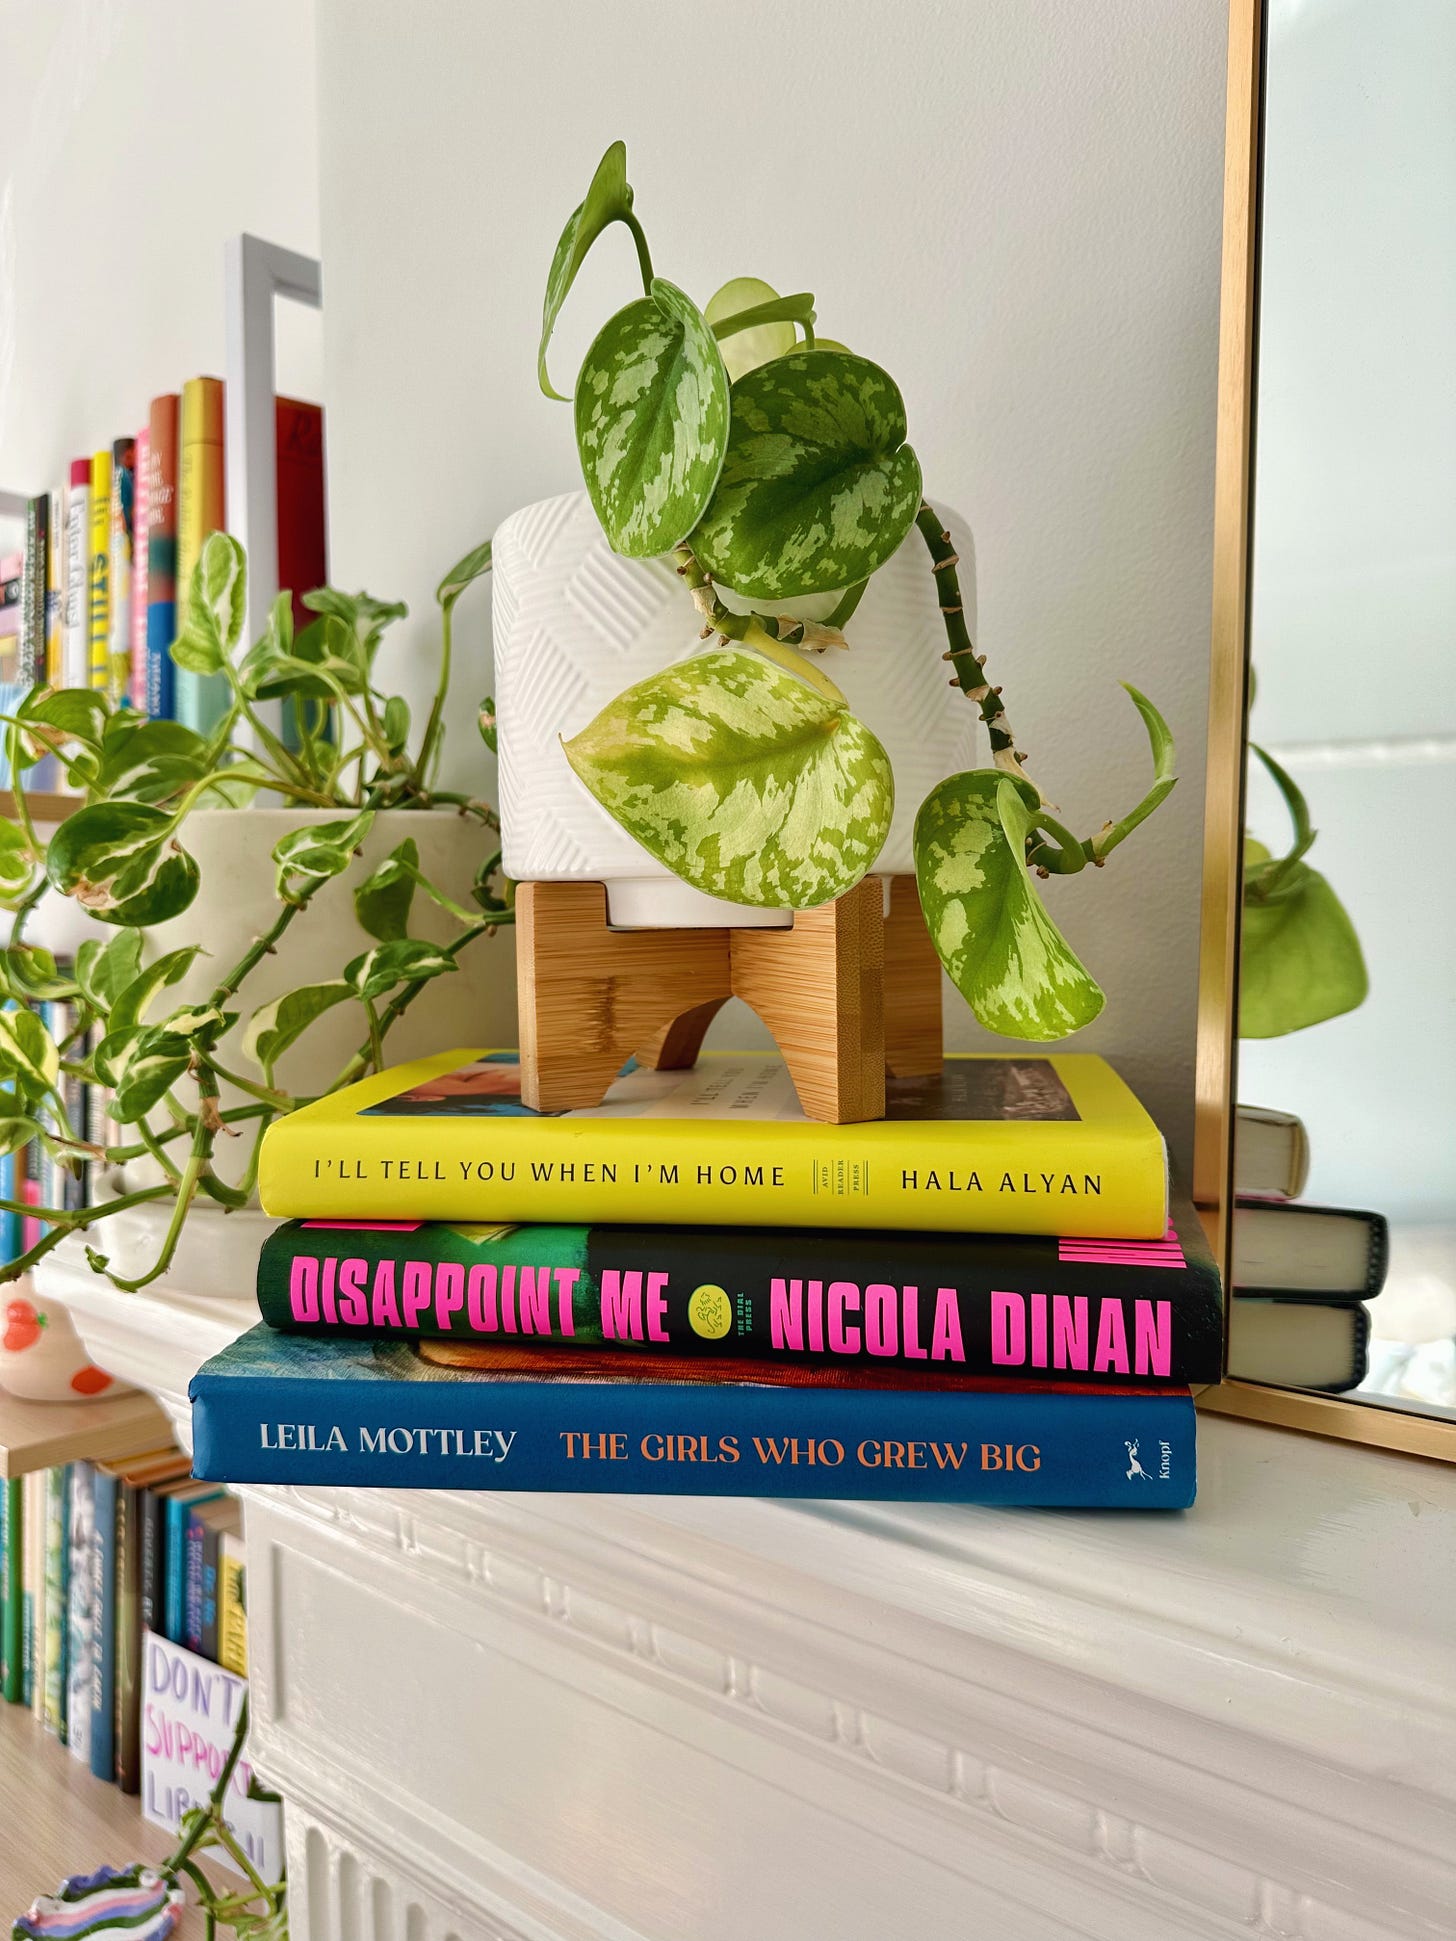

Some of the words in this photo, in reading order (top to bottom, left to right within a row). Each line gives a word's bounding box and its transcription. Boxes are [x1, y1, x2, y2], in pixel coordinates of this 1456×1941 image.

[315, 1159, 368, 1179] I'LL
[380, 1160, 446, 1180] TELL
[459, 1161, 515, 1181] YOU
[531, 1162, 617, 1183] WHEN
[634, 1164, 679, 1184] I'M
[697, 1165, 785, 1186] HOME
[852, 1164, 860, 1191] PRESS
[902, 1170, 983, 1192] HALA
[999, 1172, 1101, 1195] ALYAN
[289, 1256, 581, 1337] DISAPPOINT
[600, 1270, 671, 1343] ME
[745, 1299, 753, 1331] PRESS
[737, 1319, 745, 1336] THE
[770, 1278, 966, 1362] NICOLA
[991, 1292, 1172, 1377] DINAN
[260, 1423, 348, 1451] LEILA
[359, 1427, 518, 1464] MOTTLEY
[560, 1431, 629, 1461] THE
[640, 1434, 741, 1463] GIRLS
[751, 1437, 847, 1466] WHO
[857, 1440, 968, 1470] GREW
[980, 1443, 1042, 1473] BIG
[1158, 1440, 1172, 1480] Knopf
[150, 1644, 244, 1726] DON'T
